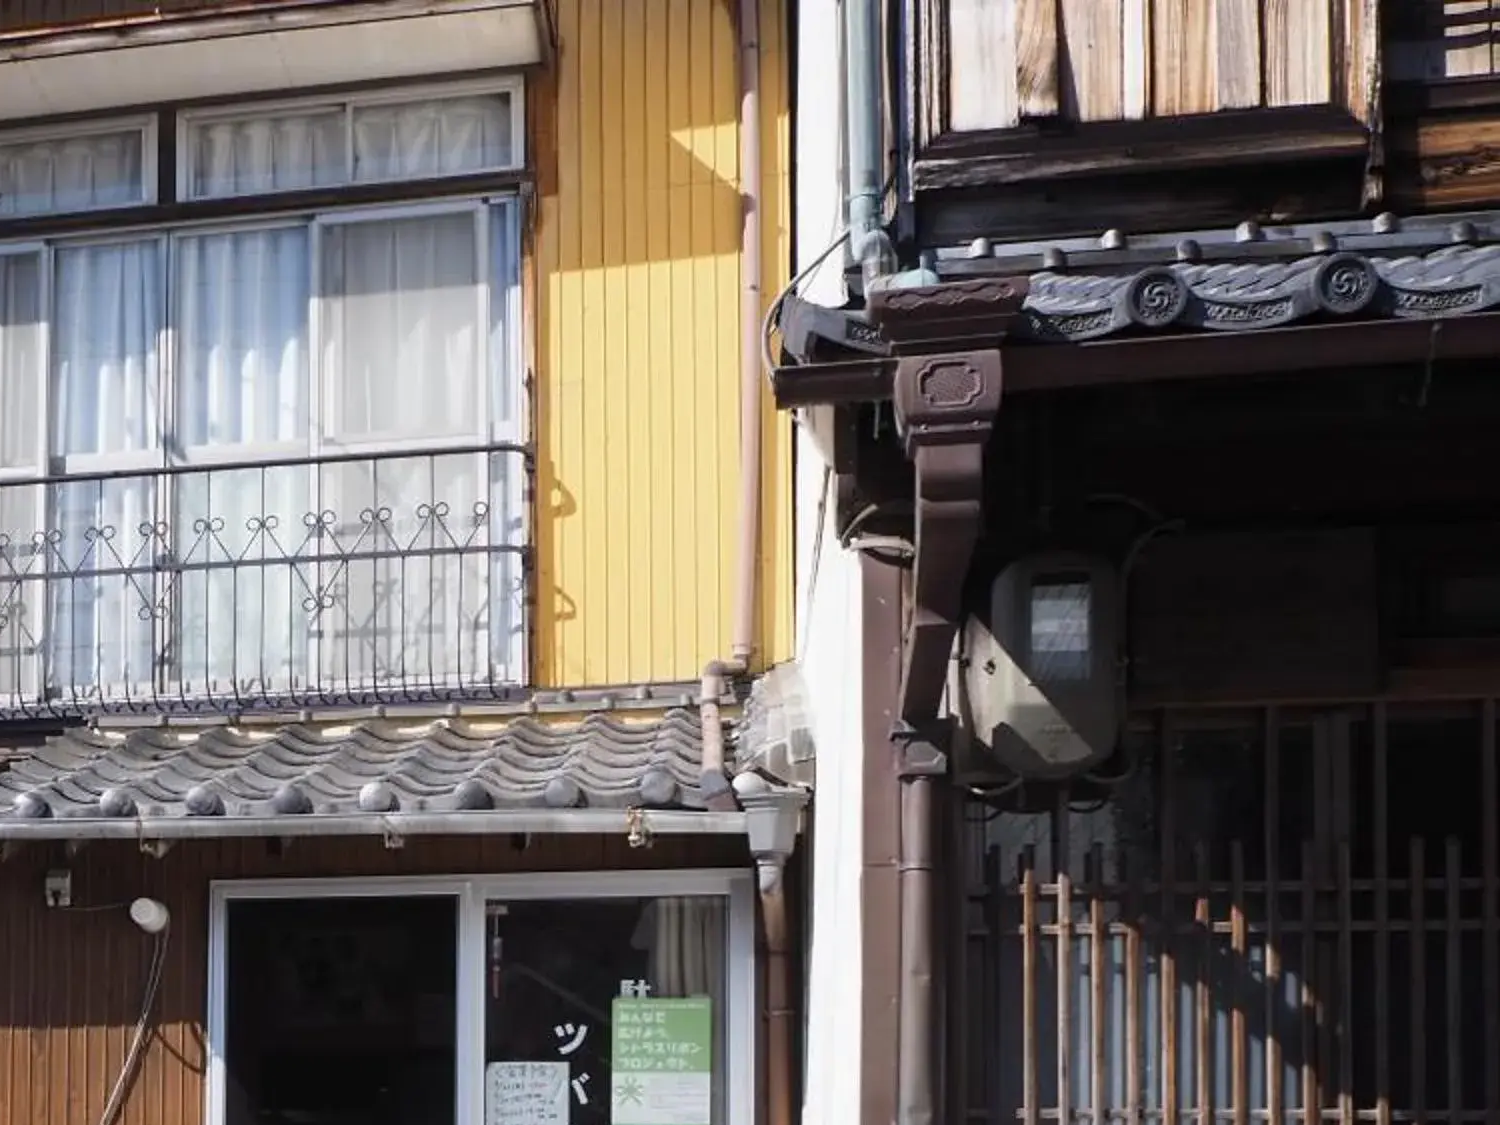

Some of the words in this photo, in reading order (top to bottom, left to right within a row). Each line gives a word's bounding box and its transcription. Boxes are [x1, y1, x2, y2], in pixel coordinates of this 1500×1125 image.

[619, 1042, 704, 1055] シトラスリボン
